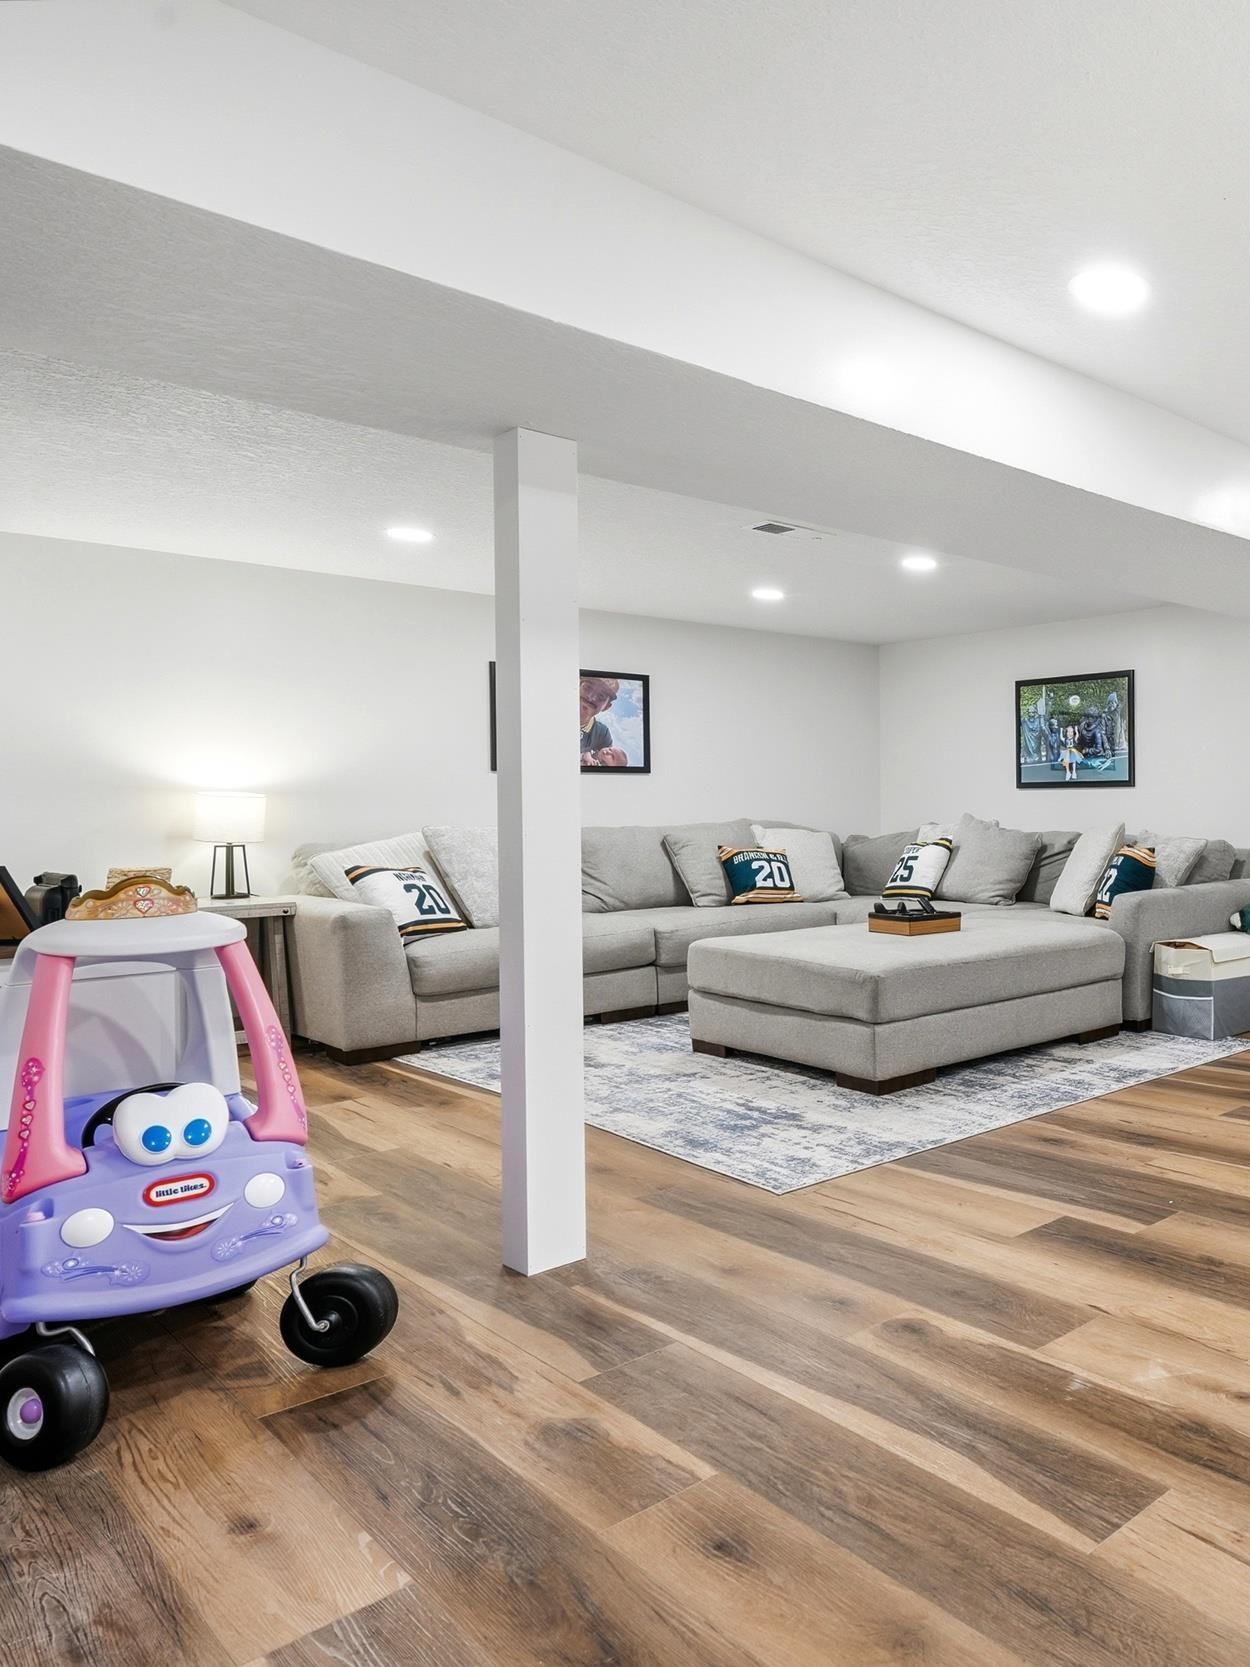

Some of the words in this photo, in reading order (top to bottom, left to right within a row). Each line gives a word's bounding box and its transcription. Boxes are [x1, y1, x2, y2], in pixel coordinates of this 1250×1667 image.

[751, 860, 791, 889] 20
[890, 855, 920, 883] 25
[403, 883, 451, 916] 20
[155, 1187, 180, 1199] little
